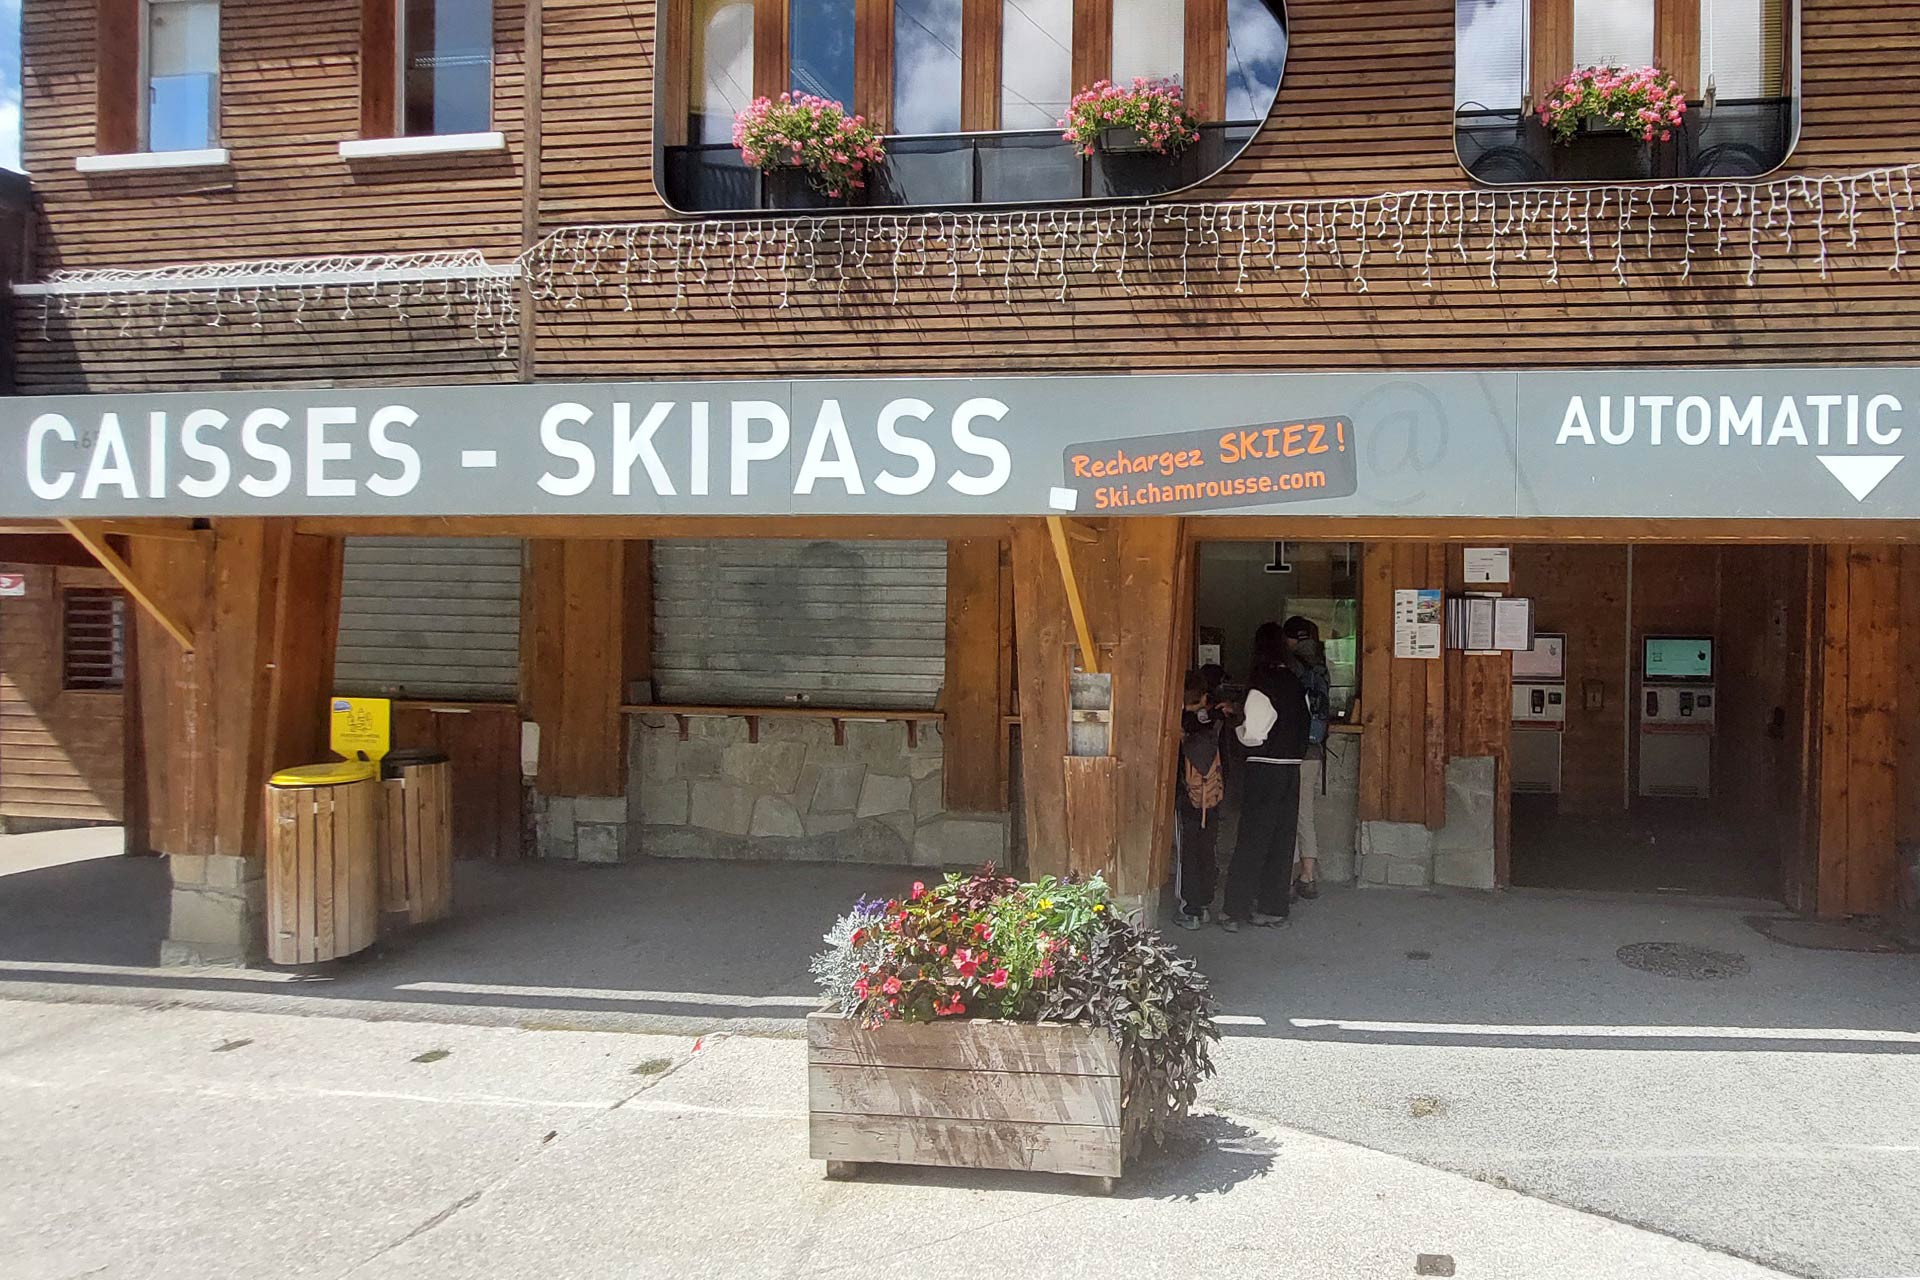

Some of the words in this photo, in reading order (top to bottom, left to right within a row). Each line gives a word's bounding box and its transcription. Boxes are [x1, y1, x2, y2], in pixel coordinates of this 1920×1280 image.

[1555, 394, 1904, 446] AUTOMATIC
[26, 406, 421, 500] CAISSES
[461, 450, 497, 468] -
[536, 397, 1012, 497] SKIPASS
[1071, 449, 1205, 478] Rechargez
[1094, 468, 1326, 509] Ski.chamrousse.com
